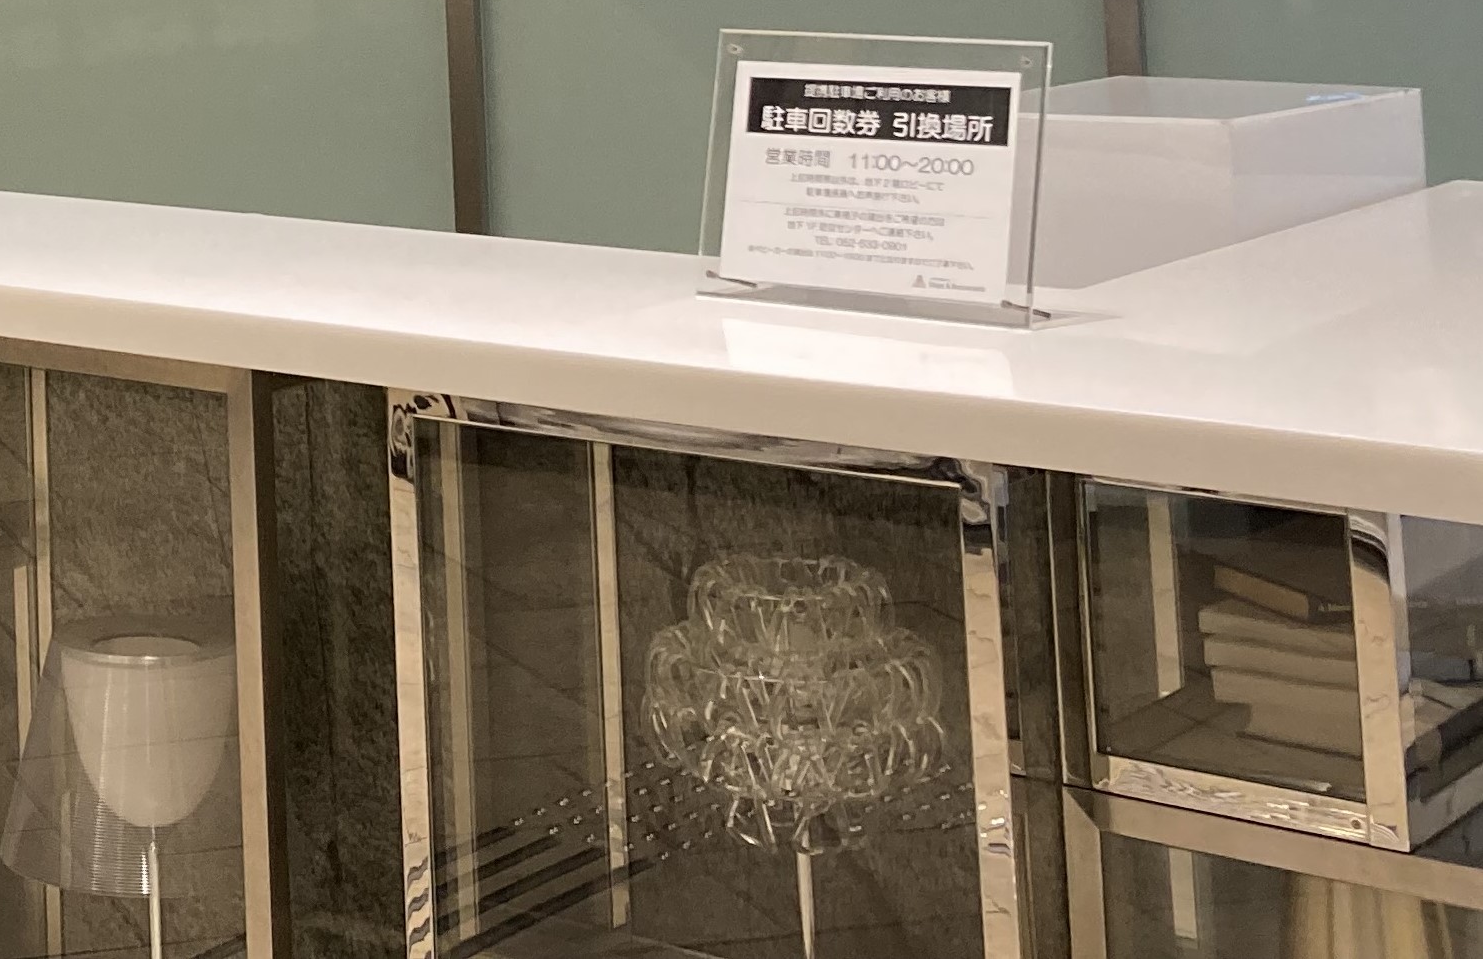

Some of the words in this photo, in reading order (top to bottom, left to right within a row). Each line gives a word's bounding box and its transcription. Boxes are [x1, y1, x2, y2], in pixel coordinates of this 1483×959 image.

[761, 105, 881, 137] 駐車回数券
[893, 112, 994, 142] 引換場所
[765, 148, 831, 169] 営業時間
